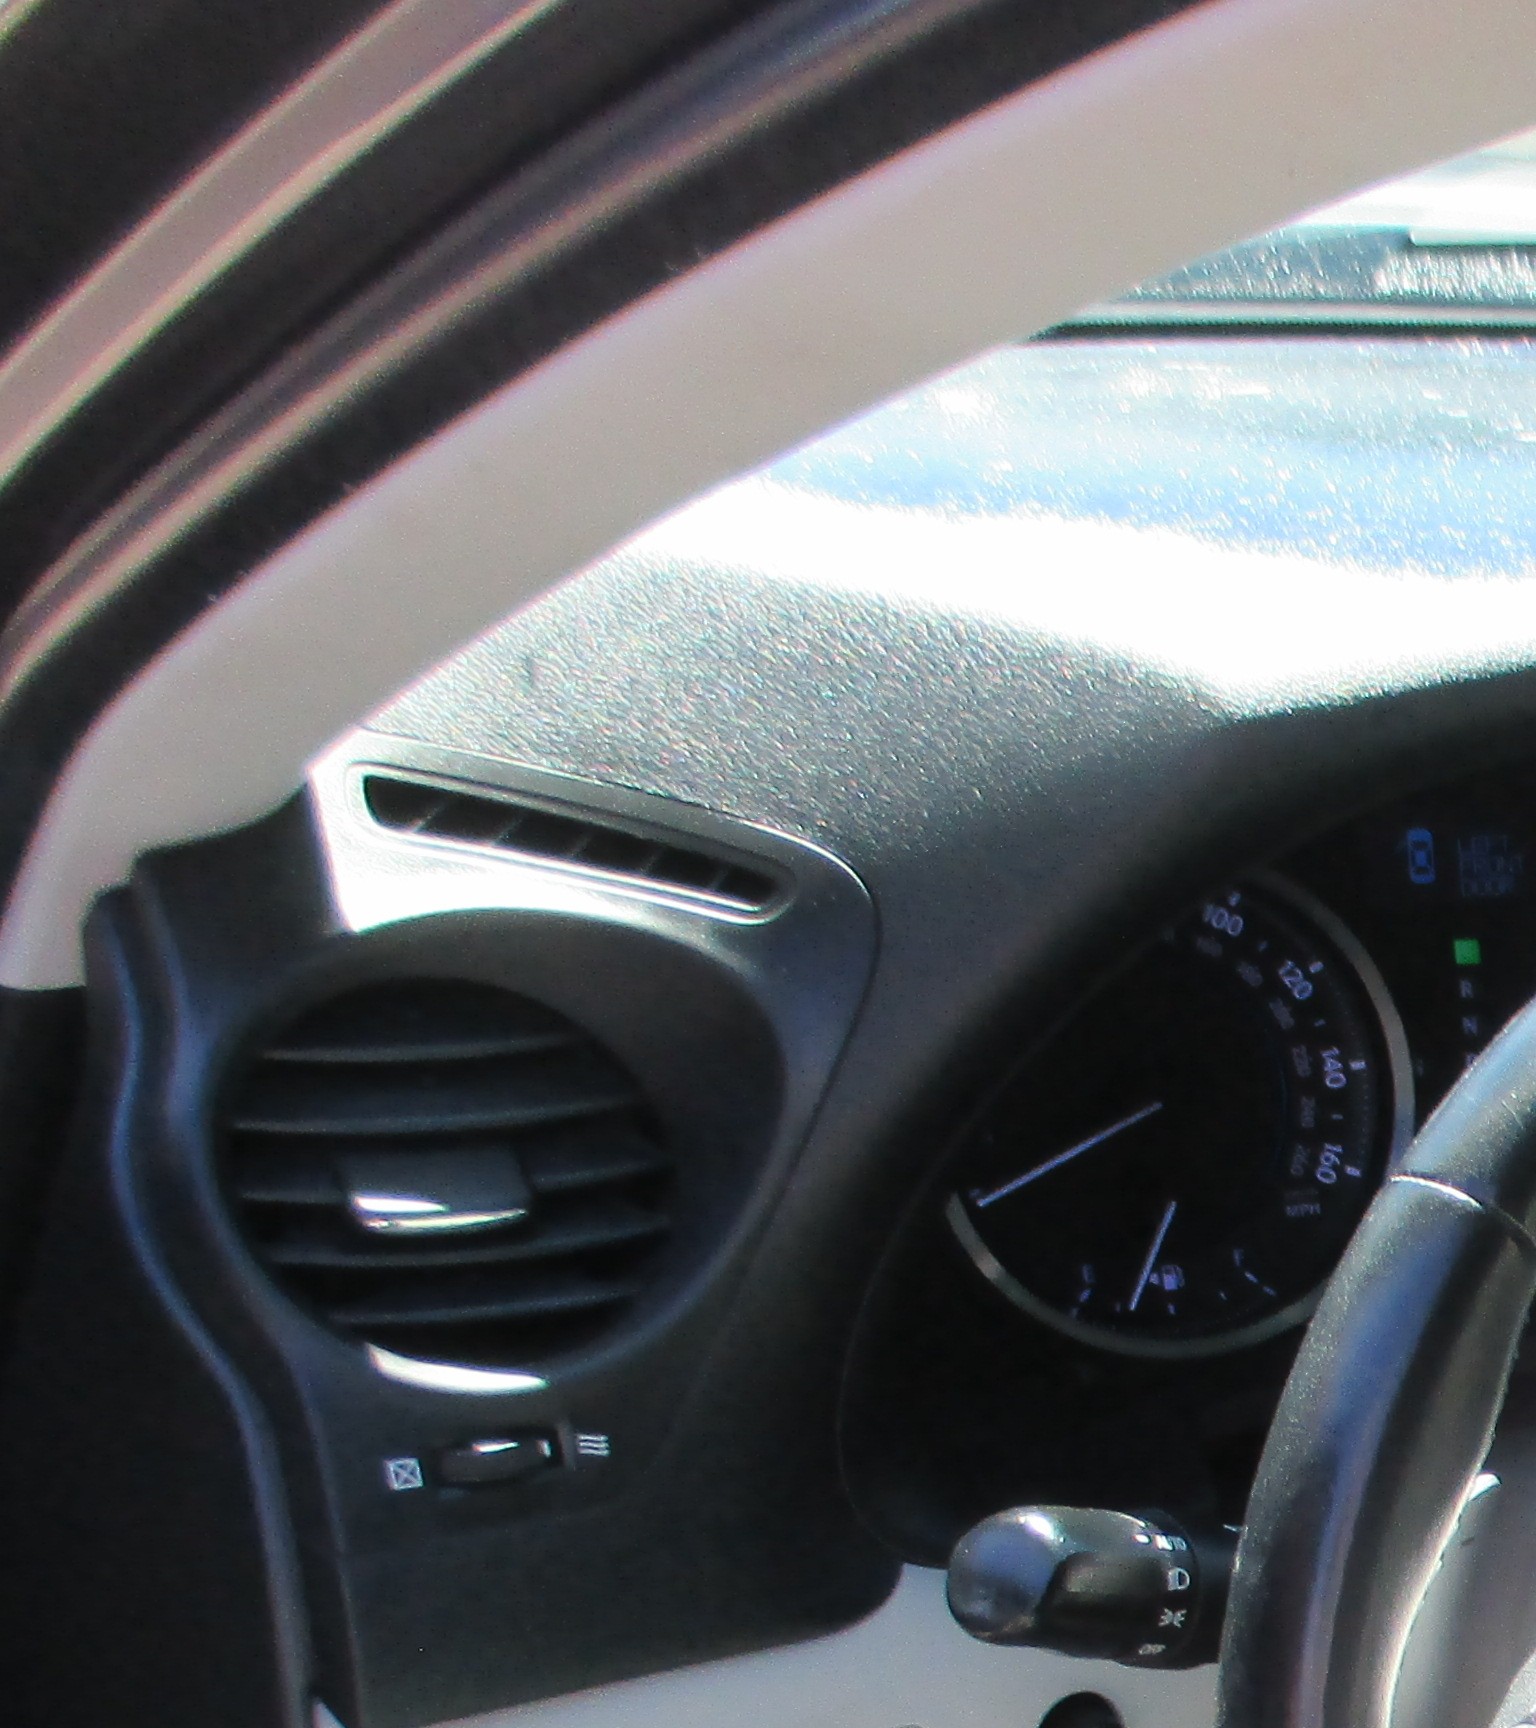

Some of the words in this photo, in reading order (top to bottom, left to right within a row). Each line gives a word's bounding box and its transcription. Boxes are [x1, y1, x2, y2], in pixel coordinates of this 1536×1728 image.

[1201, 902, 1243, 936] 100
[1278, 959, 1313, 1000] 120
[1320, 1046, 1347, 1089] 140
[1315, 1142, 1343, 1184] 160
